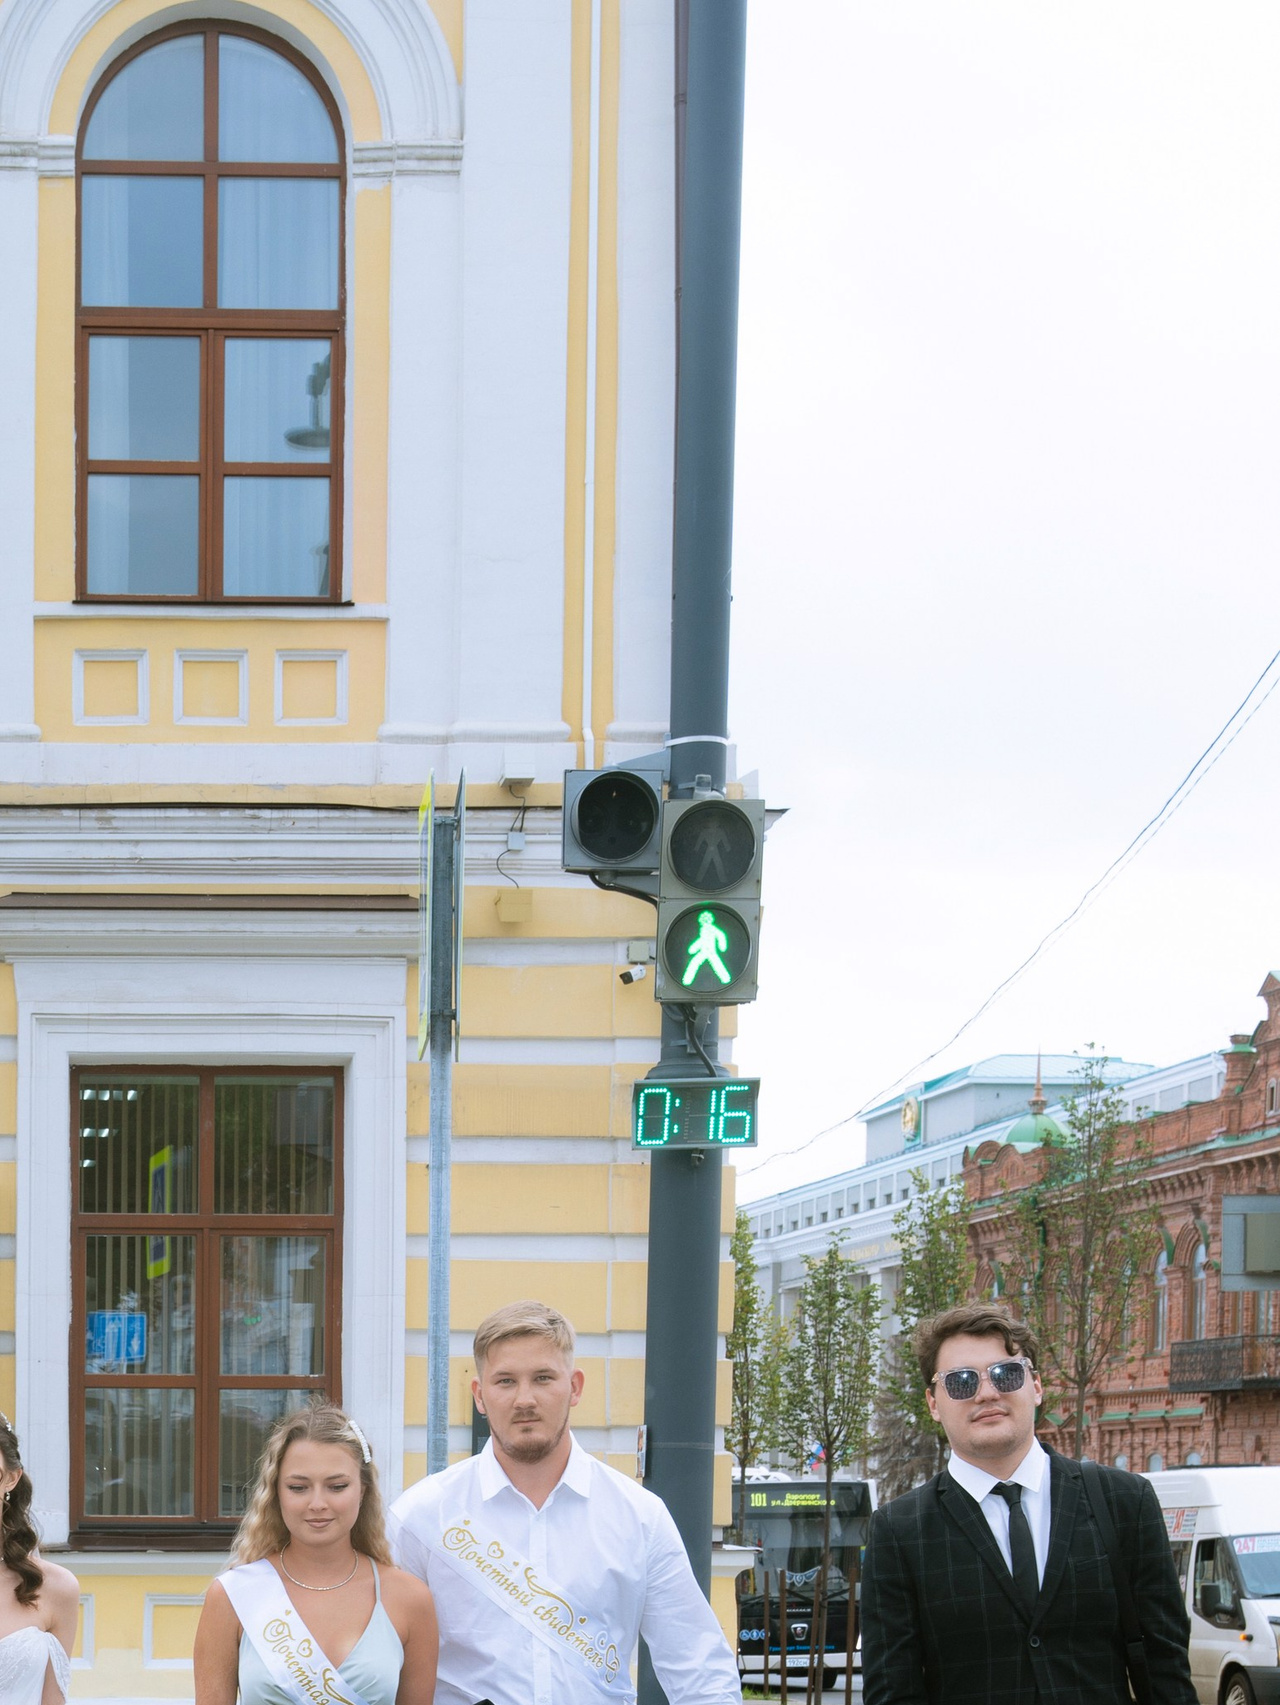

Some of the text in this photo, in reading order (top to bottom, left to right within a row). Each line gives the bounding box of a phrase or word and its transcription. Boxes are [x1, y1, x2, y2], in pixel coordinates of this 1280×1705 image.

[750, 1492, 768, 1507] 101
[785, 1492, 821, 1501] Аэропорт
[1235, 1536, 1257, 1554] 247
[524, 1567, 604, 1669] свидетель
